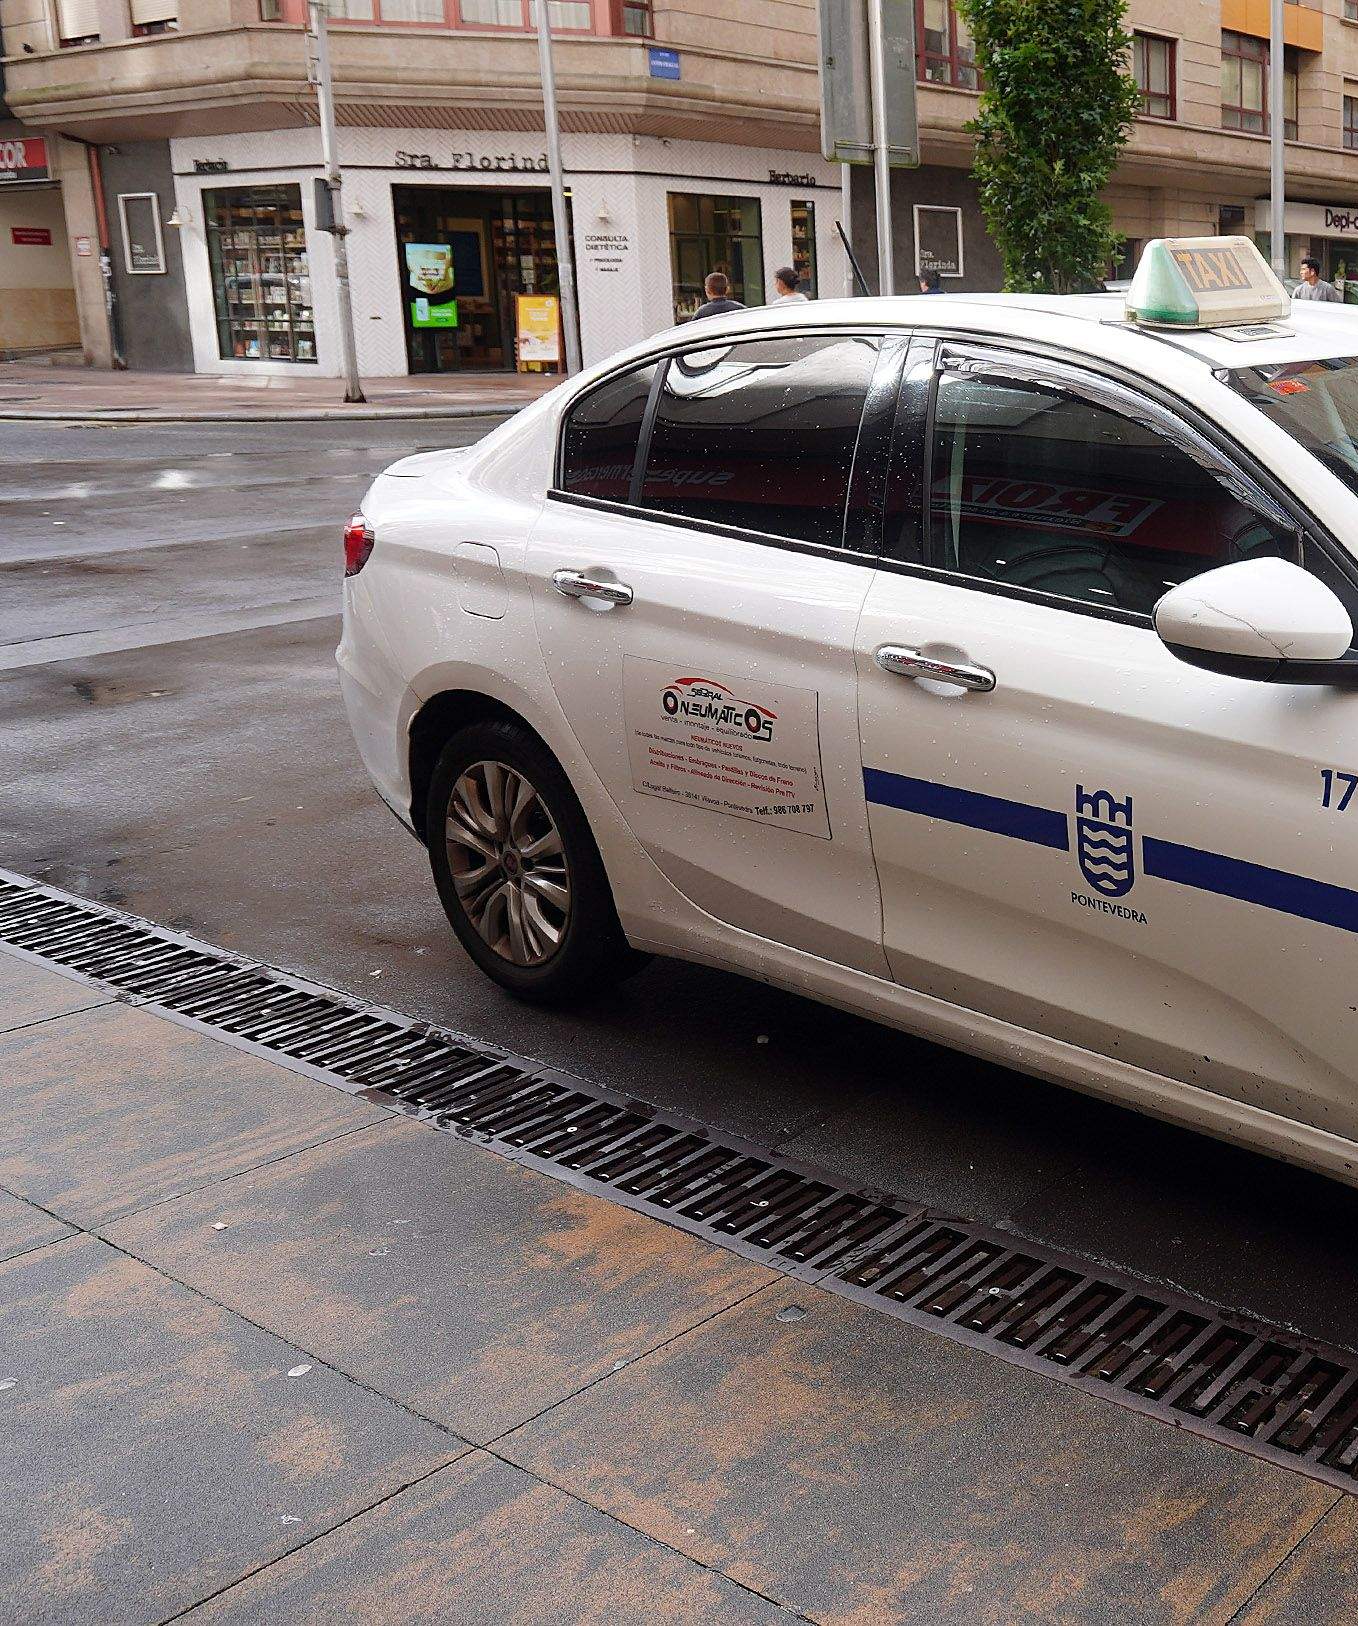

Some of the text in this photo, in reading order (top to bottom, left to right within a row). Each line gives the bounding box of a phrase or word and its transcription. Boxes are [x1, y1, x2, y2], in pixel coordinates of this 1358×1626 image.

[451, 151, 551, 172] Florind
[1175, 250, 1249, 289] TAXI
[773, 805, 787, 815] 986
[787, 804, 801, 814] 708
[801, 803, 815, 813] 797
[1070, 891, 1149, 925] PONTEVEDRA
